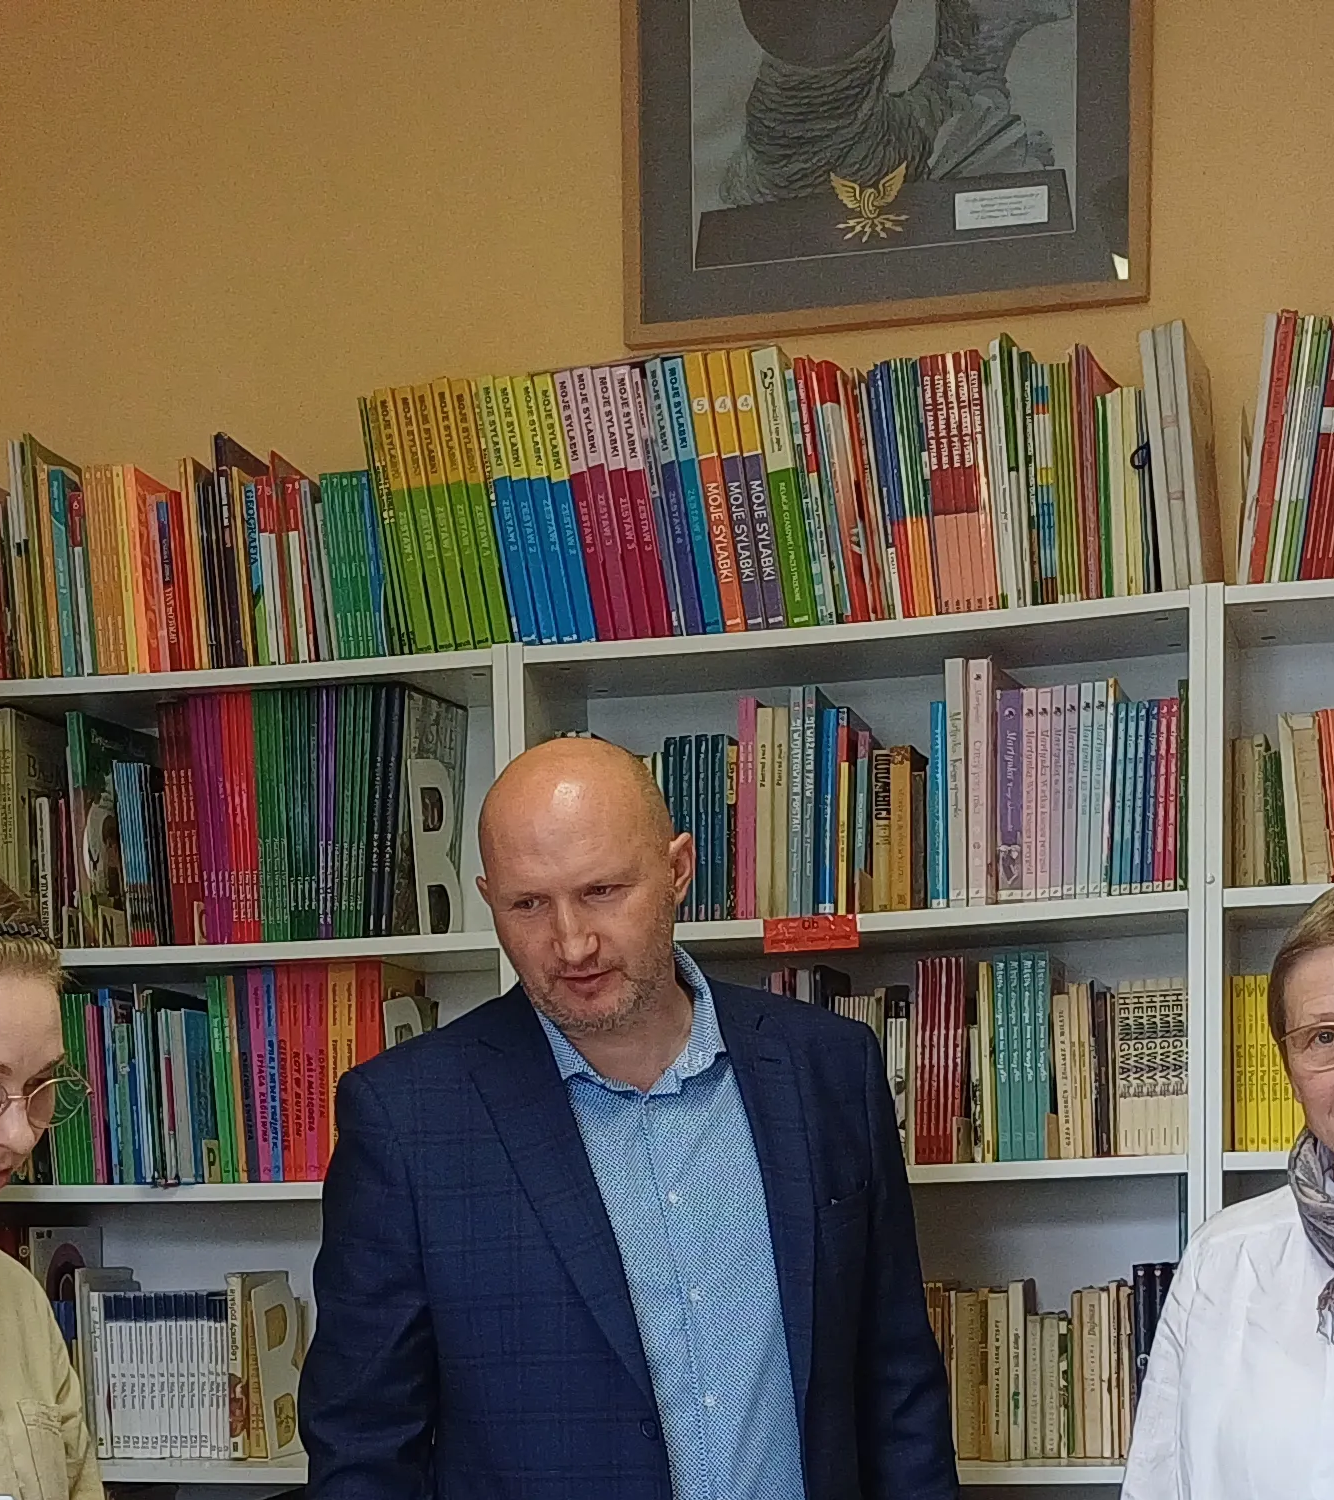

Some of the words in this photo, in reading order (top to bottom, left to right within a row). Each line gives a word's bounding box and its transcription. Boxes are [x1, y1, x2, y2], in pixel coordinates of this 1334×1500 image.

[483, 387, 494, 416] MOJE
[559, 380, 570, 412] MOJE
[577, 373, 589, 403] MOJE
[599, 376, 610, 407] MOJE
[650, 369, 659, 401] MOJE
[668, 366, 680, 399] MOJE
[674, 402, 688, 448] SYLABKI
[696, 401, 705, 412] 5
[718, 399, 728, 411] 4
[739, 397, 749, 408] 4
[542, 389, 552, 416] MOJE
[547, 419, 562, 470] SYLABKI
[564, 415, 580, 462] SYLABKI
[581, 406, 597, 454] SYLABKI
[603, 410, 620, 458] SYLABKI
[616, 378, 628, 409] MOJE
[622, 411, 638, 459] SYLABKI
[654, 404, 669, 451] SYLABKI
[487, 419, 503, 467] SYLABKI
[503, 500, 513, 536] ZESTAW
[520, 501, 531, 539] ZESTAW
[543, 499, 555, 539] ZESTAW
[578, 501, 591, 539] ZESTAW
[597, 493, 609, 534] ZESTAW
[620, 497, 631, 538] ZESTAW
[637, 498, 649, 538] ZESTAW
[669, 491, 681, 532] ZESTAW
[706, 482, 720, 519] MOJE
[750, 480, 764, 519] MOJE
[245, 489, 259, 566] GEOGRAFIA
[562, 503, 574, 543] ZESTAW
[728, 481, 742, 518] MOJE
[735, 524, 754, 582] SYLABKI
[783, 512, 794, 546] CZASOWE
[712, 523, 733, 583] SYLABKI
[756, 522, 775, 581] SYLABKI
[1004, 729, 1017, 779] Martynka
[1024, 728, 1034, 779] Martynka
[1039, 729, 1049, 777] Martynka
[1052, 728, 1062, 777] Martynka
[1066, 724, 1076, 774] Martynka
[1081, 724, 1091, 772] Martynka
[1094, 724, 1104, 771] Martynka
[102, 914, 115, 946] N
[1118, 994, 1132, 1084] HEMINGWAY
[1132, 994, 1146, 1084] HEMINGWAY
[1145, 994, 1159, 1084] HEMINGWAY
[1158, 994, 1172, 1084] HEMINGWAY
[1171, 994, 1184, 1084] HEMINGWAY
[292, 1051, 301, 1076] KOT
[294, 1091, 302, 1138] BUTACH
[208, 1148, 217, 1178] P
[229, 1287, 238, 1317] polskie
[229, 1318, 240, 1362] Legendy
